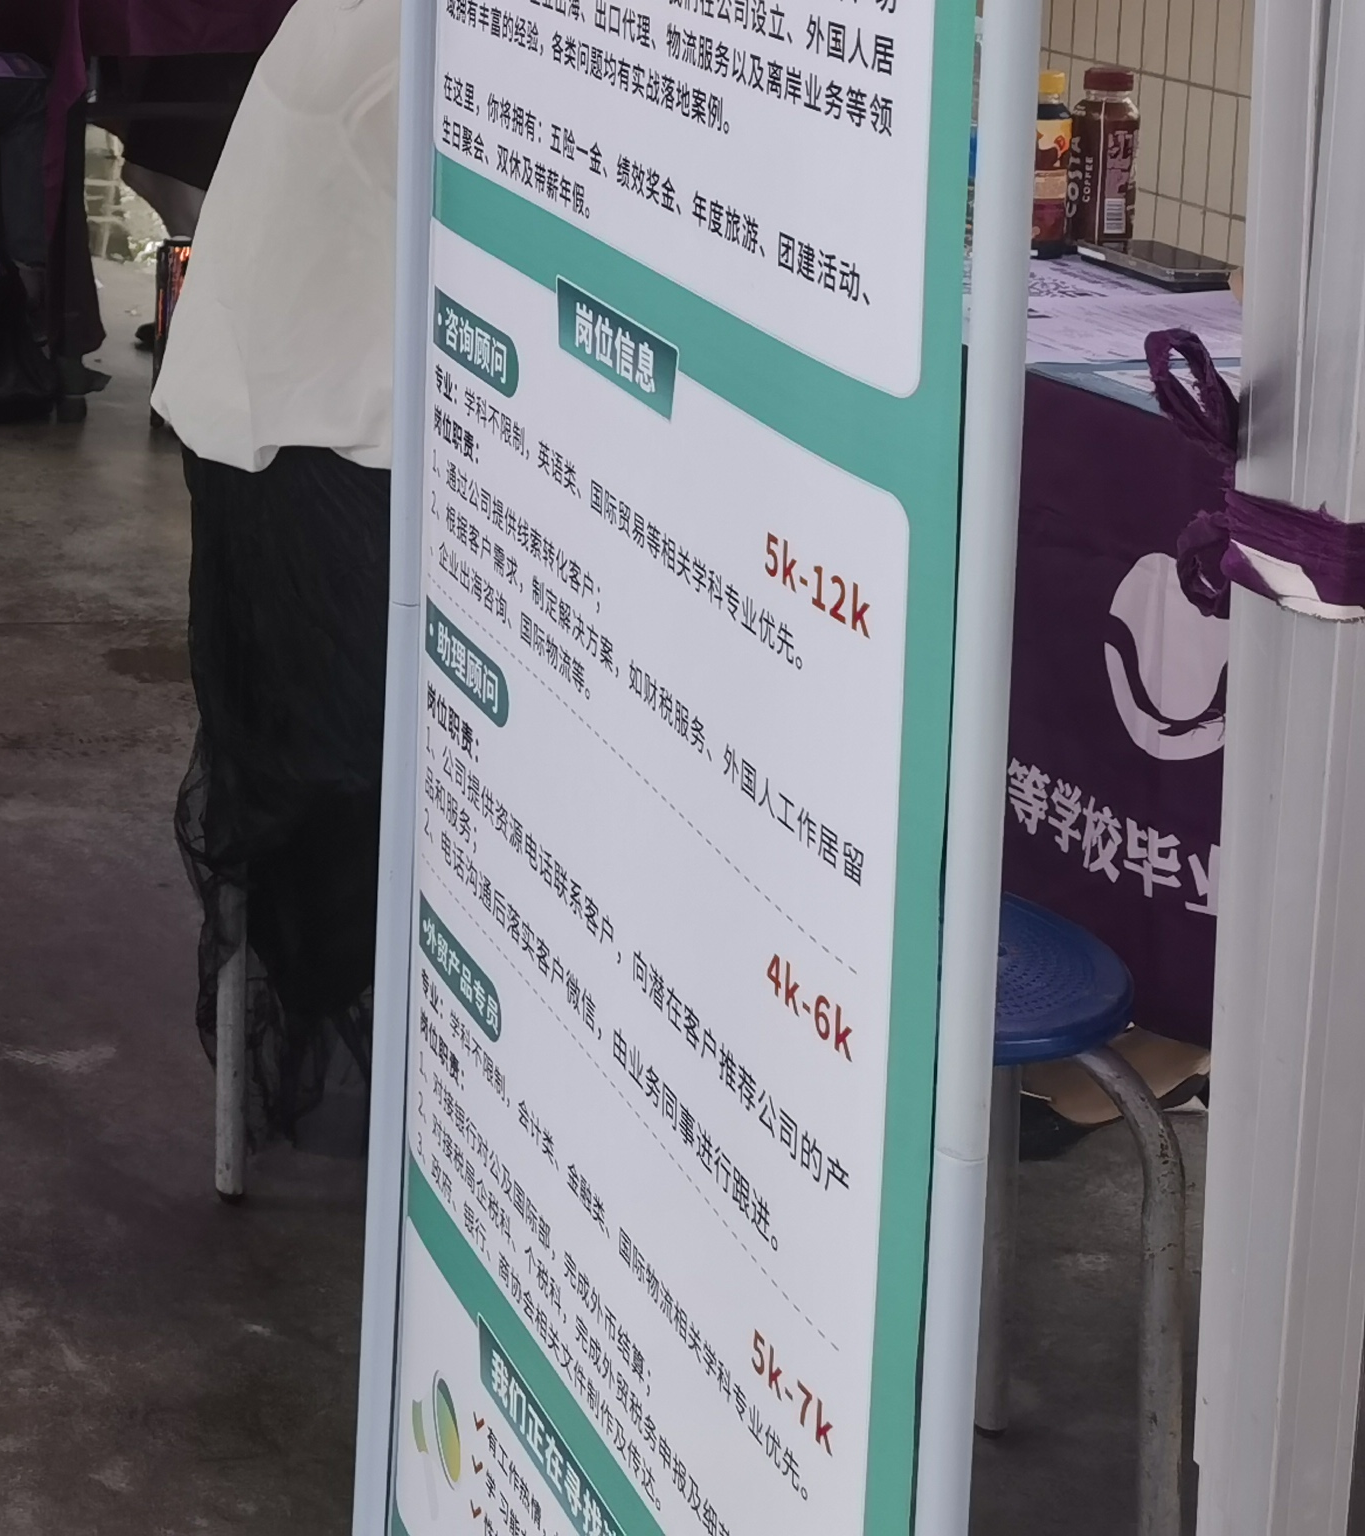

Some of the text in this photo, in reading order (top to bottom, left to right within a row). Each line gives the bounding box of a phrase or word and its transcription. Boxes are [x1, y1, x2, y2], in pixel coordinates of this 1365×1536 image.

[441, 116, 591, 220] 生日聚会、双休及带薪年假。
[1066, 136, 1083, 218] COSTA
[1082, 156, 1094, 203] COFFEE
[444, 308, 507, 385] 咨询顾问
[575, 301, 657, 394] 岗位信息
[765, 532, 870, 639] 5k-12k
[437, 622, 499, 714] 助理顾问
[767, 953, 852, 1062] 4k-6k
[418, 1091, 730, 1536] 2、对接税局企税科、个税科，完成外贸税务申报及细
[751, 1329, 833, 1457] 5k-7k
